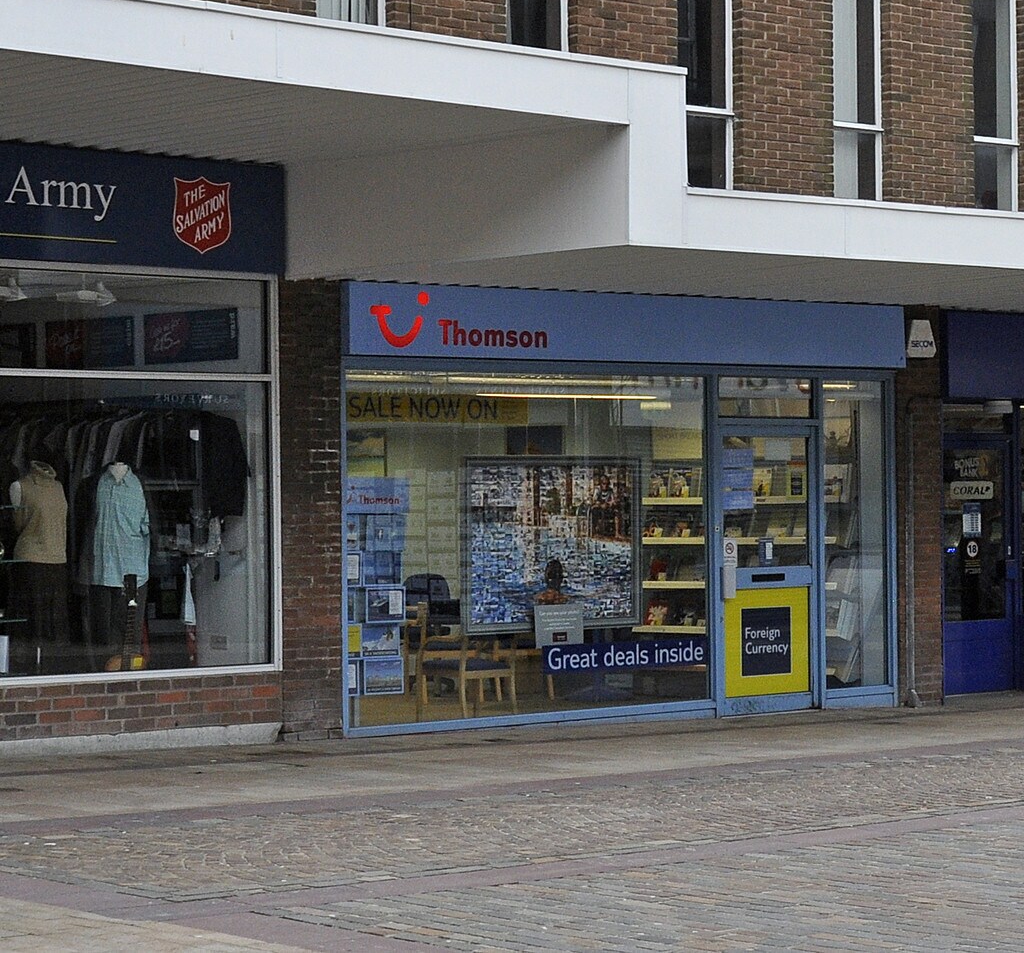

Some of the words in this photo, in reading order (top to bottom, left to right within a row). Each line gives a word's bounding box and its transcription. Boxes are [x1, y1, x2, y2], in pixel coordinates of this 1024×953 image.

[5, 165, 117, 222] Army
[184, 184, 206, 207] THE
[176, 190, 226, 233] SALVATION
[194, 212, 224, 243] ARMY
[438, 319, 548, 348] Thomson
[350, 396, 400, 418] SALE
[409, 397, 460, 418] NOW
[467, 399, 497, 419] ON
[954, 457, 980, 470] BONUS
[359, 496, 400, 505] Thomson
[953, 486, 985, 495] CORAL
[968, 544, 976, 553] 18
[745, 626, 781, 641] Foreign
[548, 648, 598, 670] Great
[604, 644, 649, 667] deals
[654, 641, 704, 663] inside
[745, 642, 789, 655] Currency
